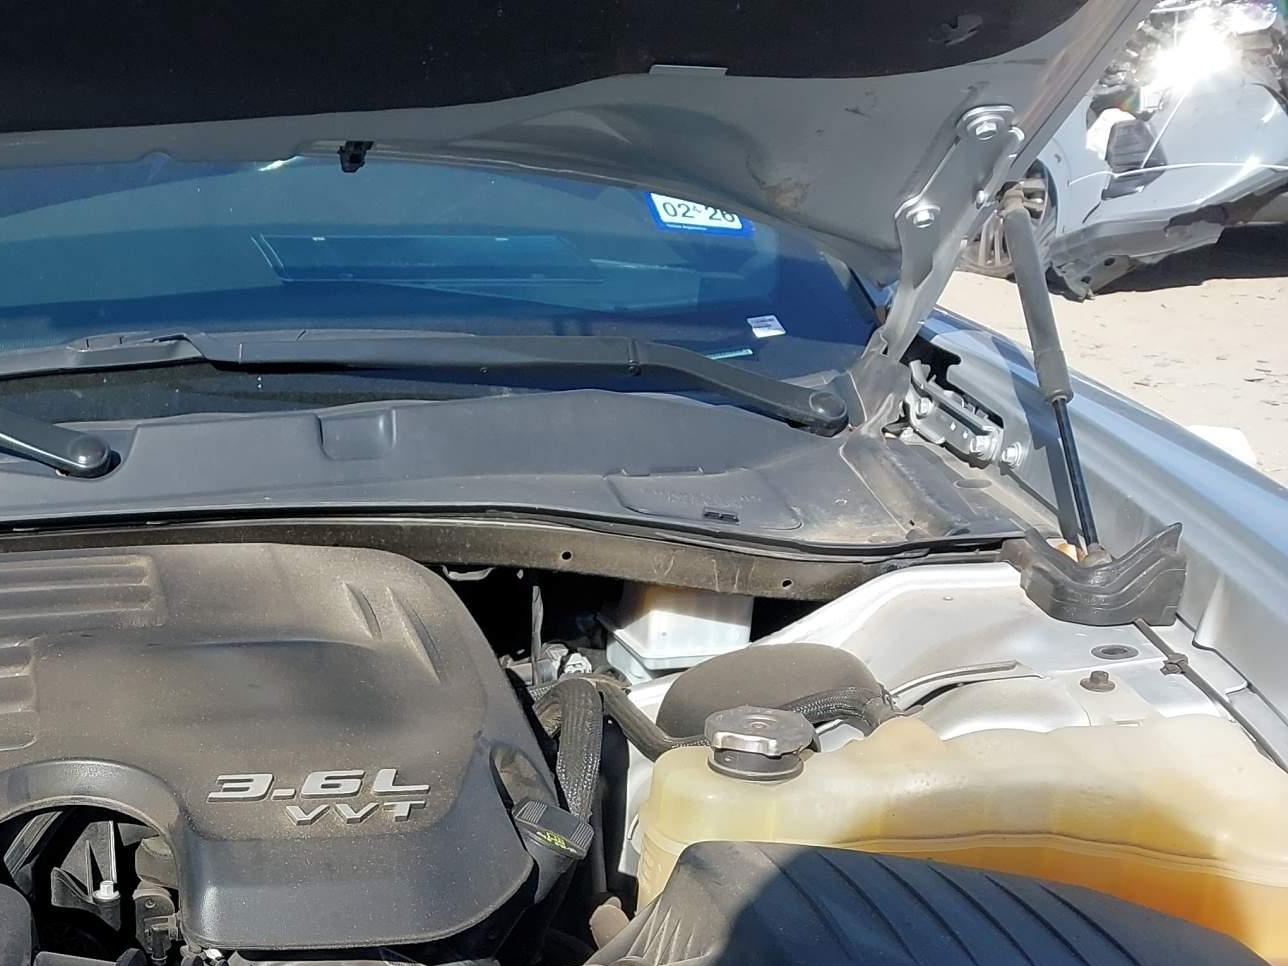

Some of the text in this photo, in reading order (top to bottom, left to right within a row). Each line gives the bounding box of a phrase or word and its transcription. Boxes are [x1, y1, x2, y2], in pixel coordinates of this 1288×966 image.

[662, 201, 695, 219] 02
[207, 768, 430, 802] 3.6L
[285, 800, 427, 826] VVT
